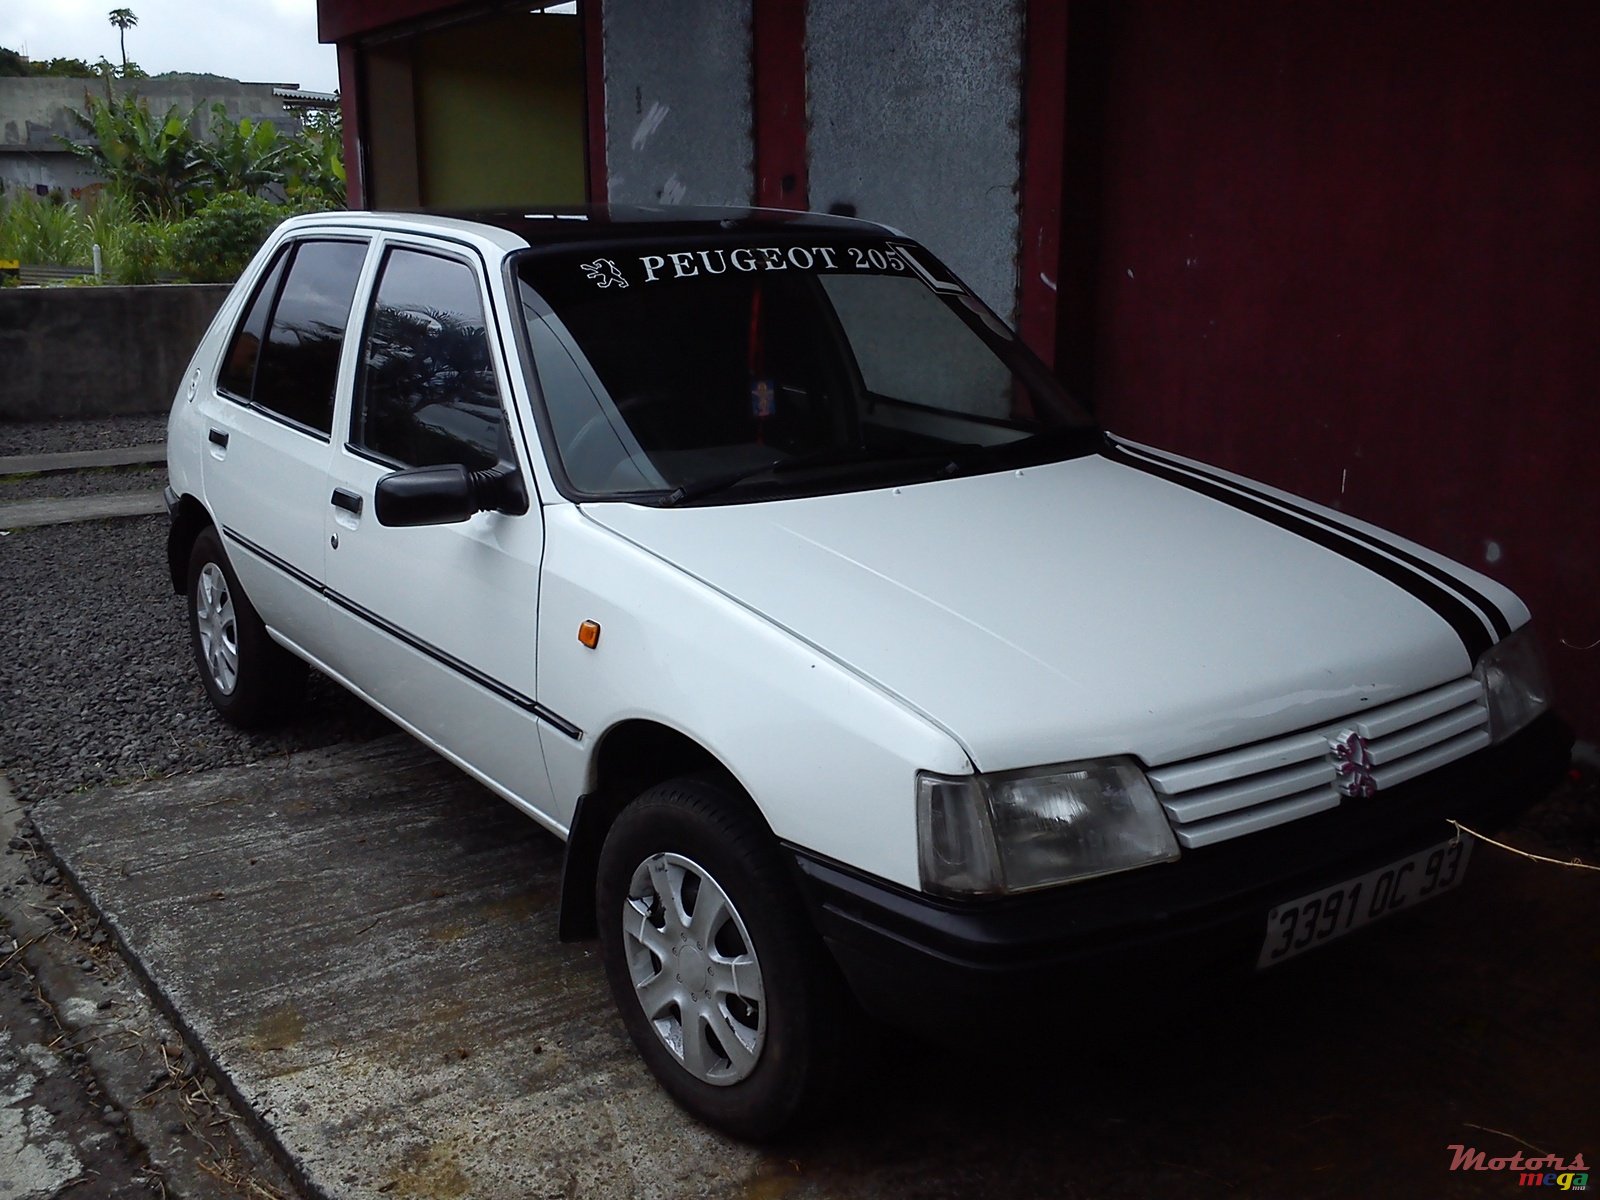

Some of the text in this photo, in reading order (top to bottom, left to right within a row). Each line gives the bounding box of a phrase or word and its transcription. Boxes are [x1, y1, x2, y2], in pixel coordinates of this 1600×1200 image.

[639, 247, 905, 283] PEUGEOT 205
[1271, 882, 1362, 959] 3391
[1419, 841, 1464, 896] 93
